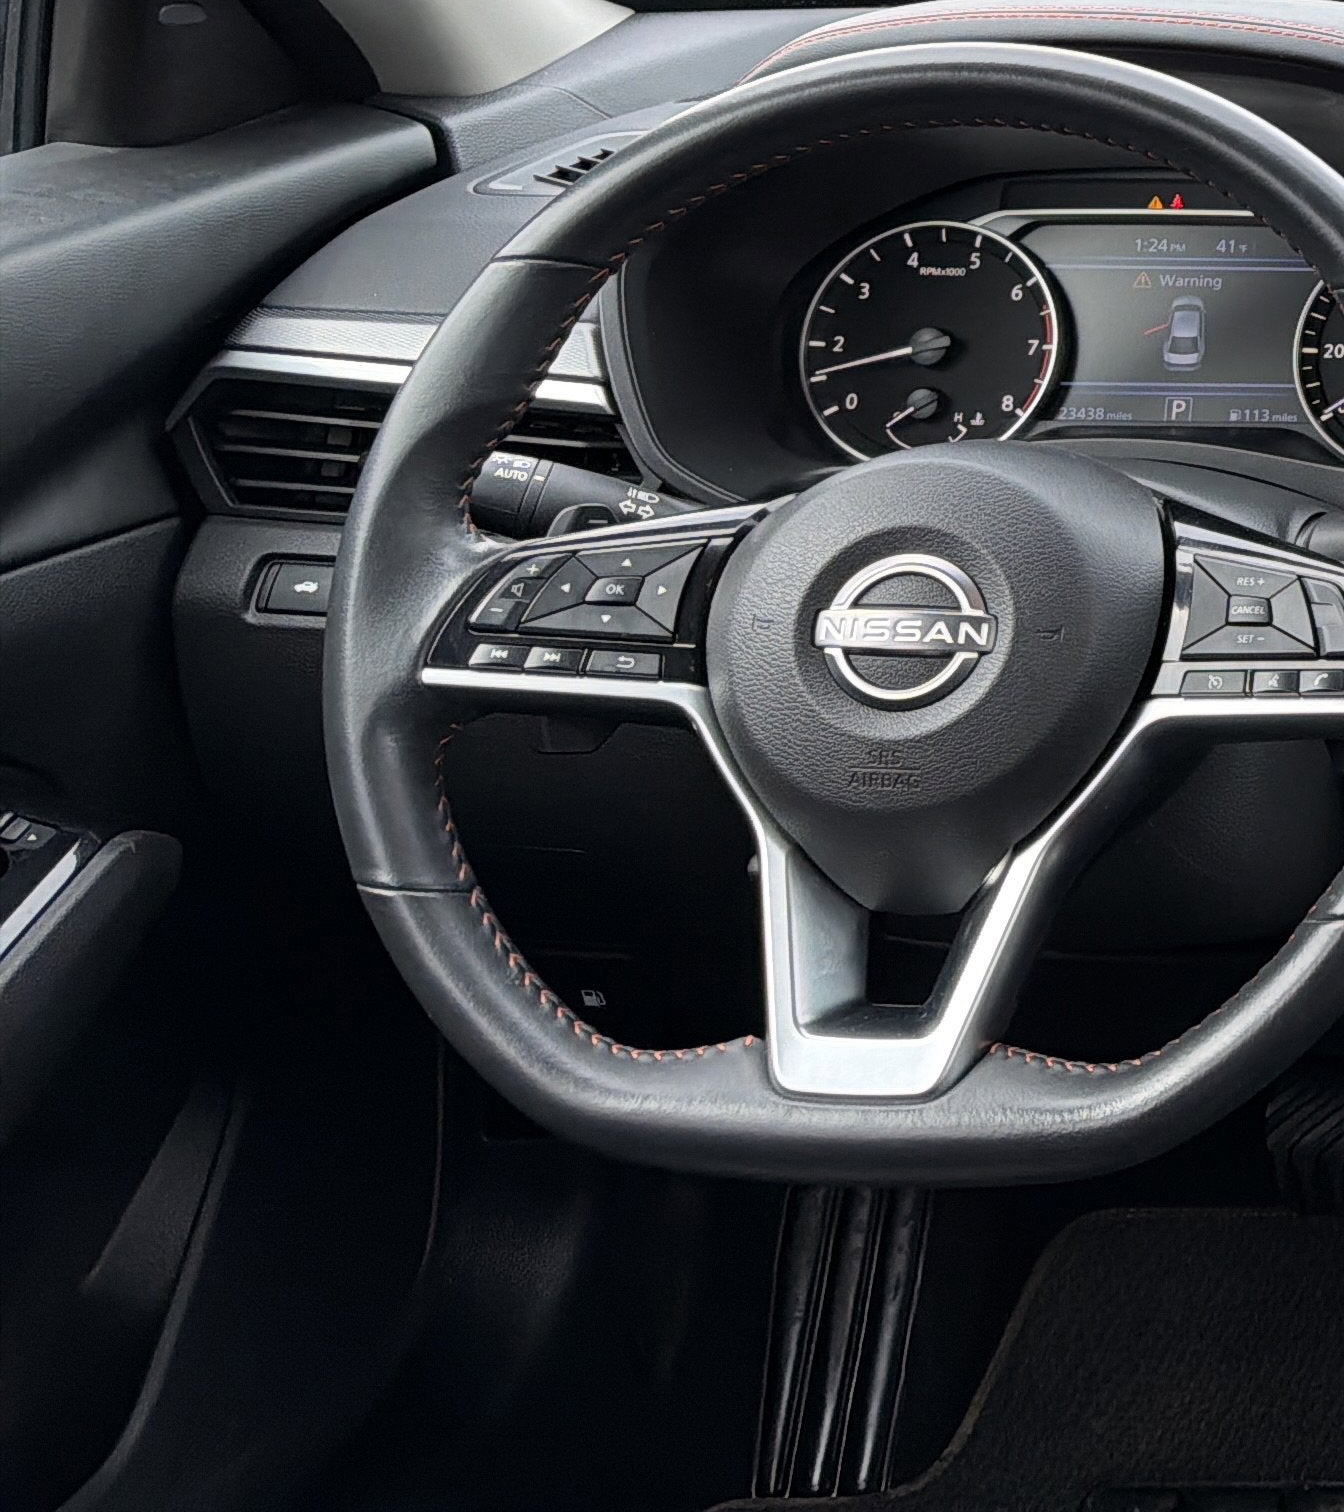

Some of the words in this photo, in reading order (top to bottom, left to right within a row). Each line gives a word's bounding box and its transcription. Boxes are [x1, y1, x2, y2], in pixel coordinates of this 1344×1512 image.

[1135, 238, 1168, 252] 1:24
[1170, 243, 1186, 252] PM
[1216, 239, 1235, 254] 41
[907, 251, 919, 268] 4
[969, 252, 980, 269] 5
[1159, 275, 1223, 290] Warning
[858, 283, 870, 300] 3
[1010, 284, 1023, 301] 6
[832, 336, 845, 353] 2
[1028, 340, 1040, 356] 7
[1323, 343, 1344, 359] 20
[846, 393, 858, 410] 0
[1002, 395, 1014, 411] 8
[954, 412, 963, 422] H
[1058, 407, 1105, 420] 23438
[1106, 411, 1133, 421] miles
[1171, 400, 1187, 421] P
[1244, 408, 1270, 422] 113
[1272, 412, 1298, 422] miles
[494, 467, 530, 482] AUTO
[605, 583, 625, 595] OK
[1236, 576, 1255, 586] RES
[1231, 605, 1266, 615] CANCEL
[819, 617, 989, 646] NISSAN
[1236, 634, 1255, 644] SET
[866, 749, 902, 766] SRS
[849, 772, 921, 790] AIRBAG
